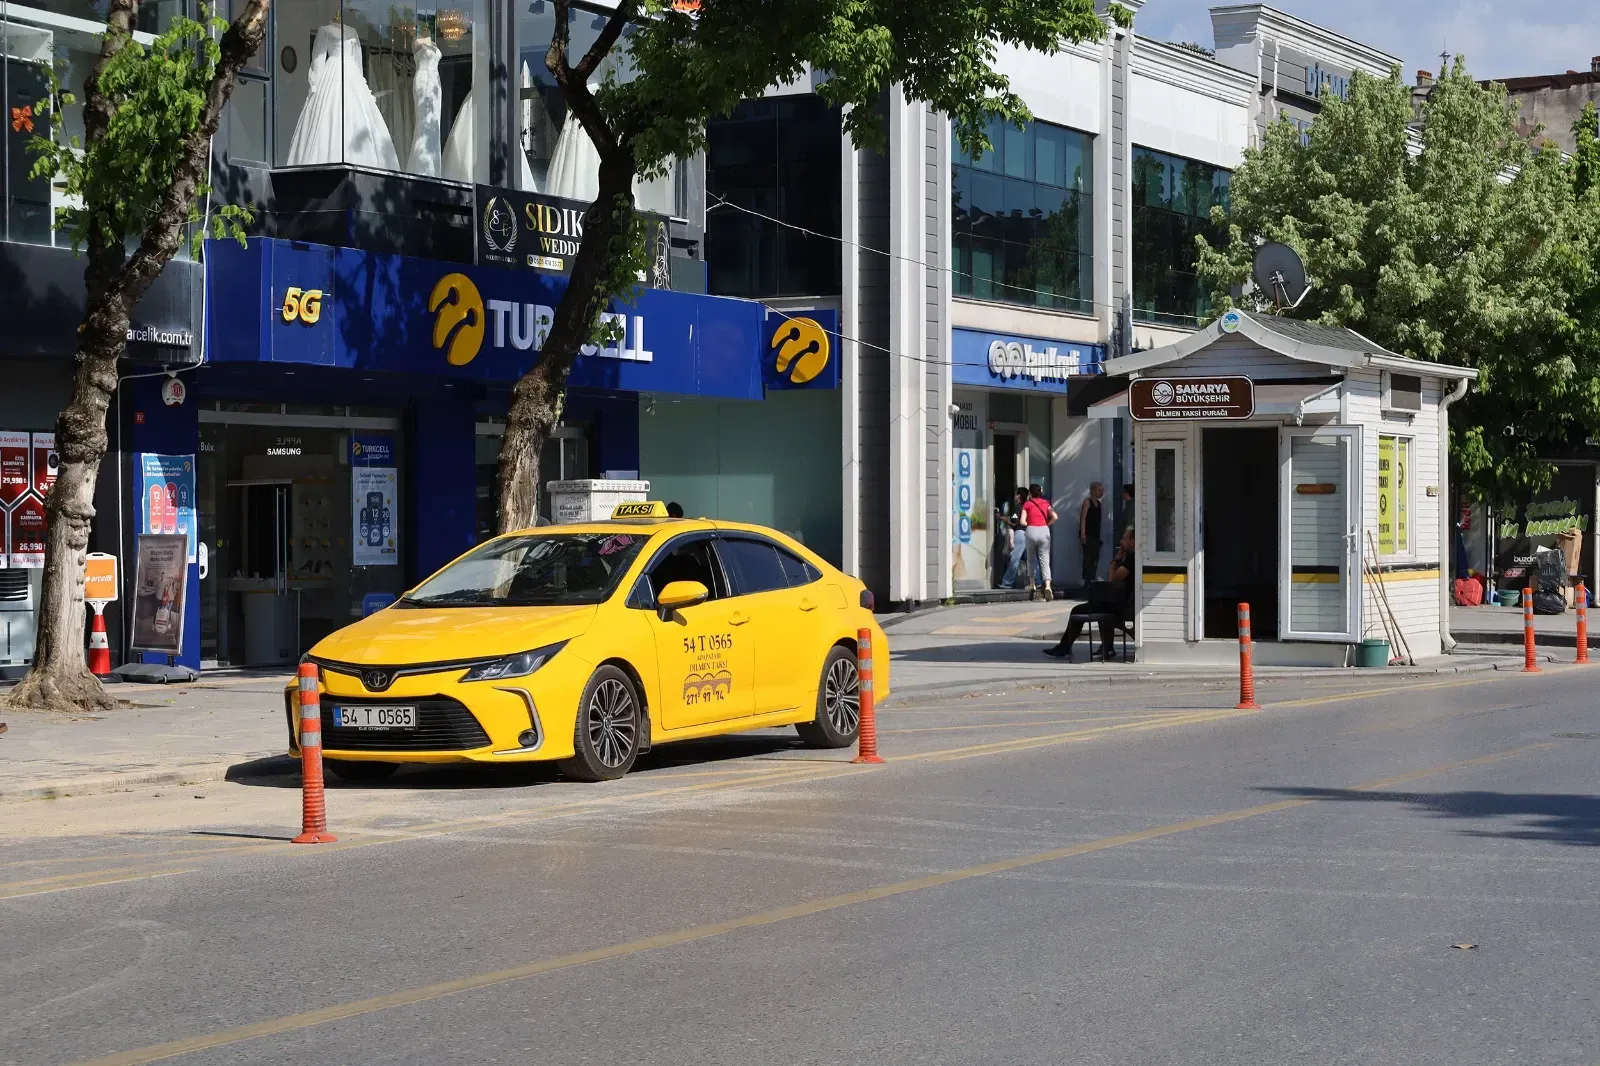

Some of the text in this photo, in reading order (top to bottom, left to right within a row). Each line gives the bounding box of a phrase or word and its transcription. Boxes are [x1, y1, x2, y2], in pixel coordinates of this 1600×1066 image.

[283, 286, 322, 323] 5G
[1176, 384, 1230, 394] SAKARYA
[1176, 394, 1230, 404] BÜYÜKŞEHİR
[1182, 409, 1201, 417] TAKSİ
[1202, 409, 1228, 417] DURAĞI
[267, 447, 302, 456] SAMSUNG
[361, 445, 390, 454] TURKCELL
[20, 543, 43, 552] 26,990
[683, 633, 733, 654] 54 T 0565
[686, 693, 698, 705] 271
[702, 691, 711, 703] 97
[342, 708, 411, 725] 54 T 0565
